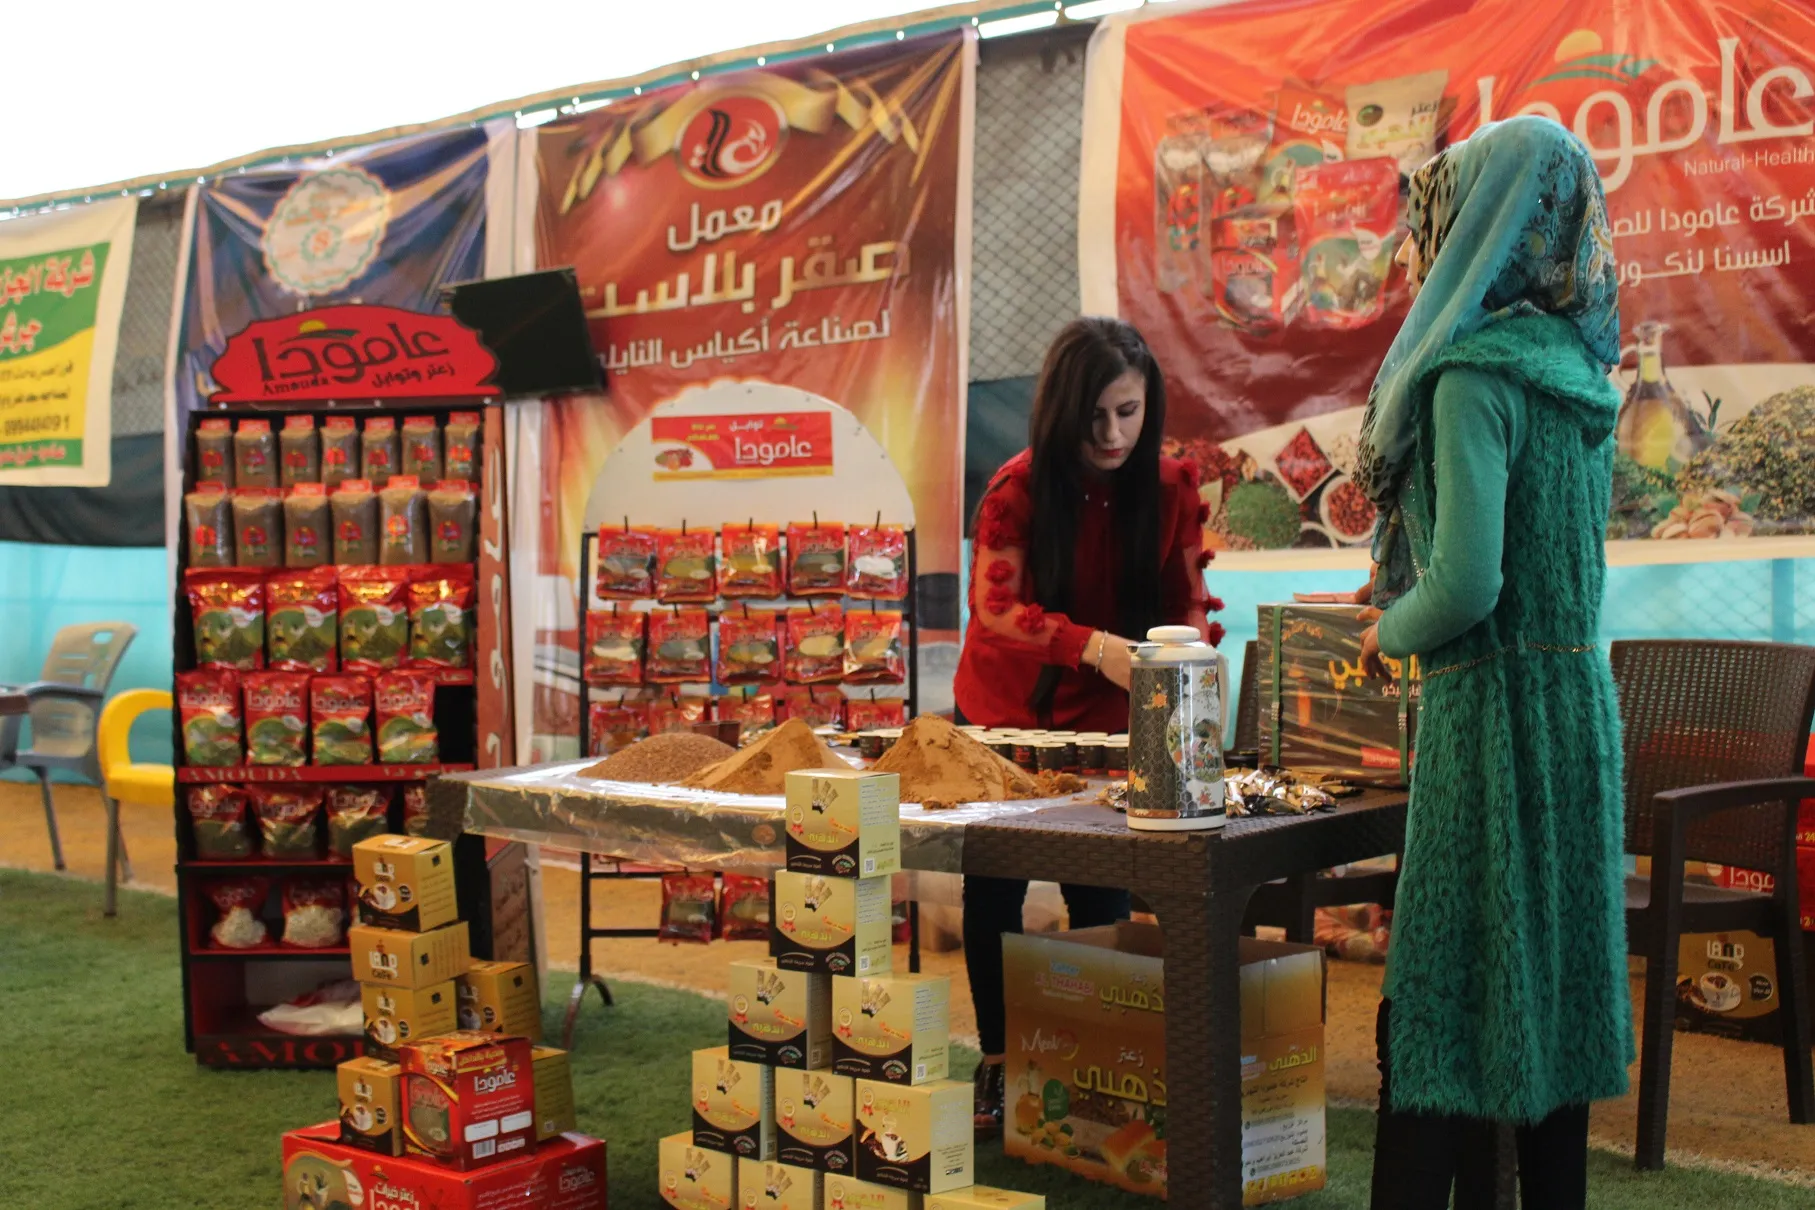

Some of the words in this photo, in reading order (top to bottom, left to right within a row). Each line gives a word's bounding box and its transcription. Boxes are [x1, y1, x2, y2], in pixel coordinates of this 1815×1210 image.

[667, 200, 783, 252] معمل
[1612, 208, 1651, 238] للص
[1660, 201, 1740, 237] عامودا
[43, 248, 95, 298] شركة
[771, 236, 911, 310] صقر
[1714, 239, 1790, 272] اسسنا
[584, 249, 756, 314] بلاست
[670, 317, 769, 369] أكياس
[778, 309, 890, 351] لصناعة
[252, 323, 450, 384] عامودا
[263, 376, 329, 397] Amouda
[734, 434, 812, 465] عامودا
[187, 767, 307, 782] AMOUDA
[1099, 984, 1164, 1014] ذهبي
[474, 1068, 517, 1094] عامودا
[1074, 1061, 1167, 1108] ذهبي
